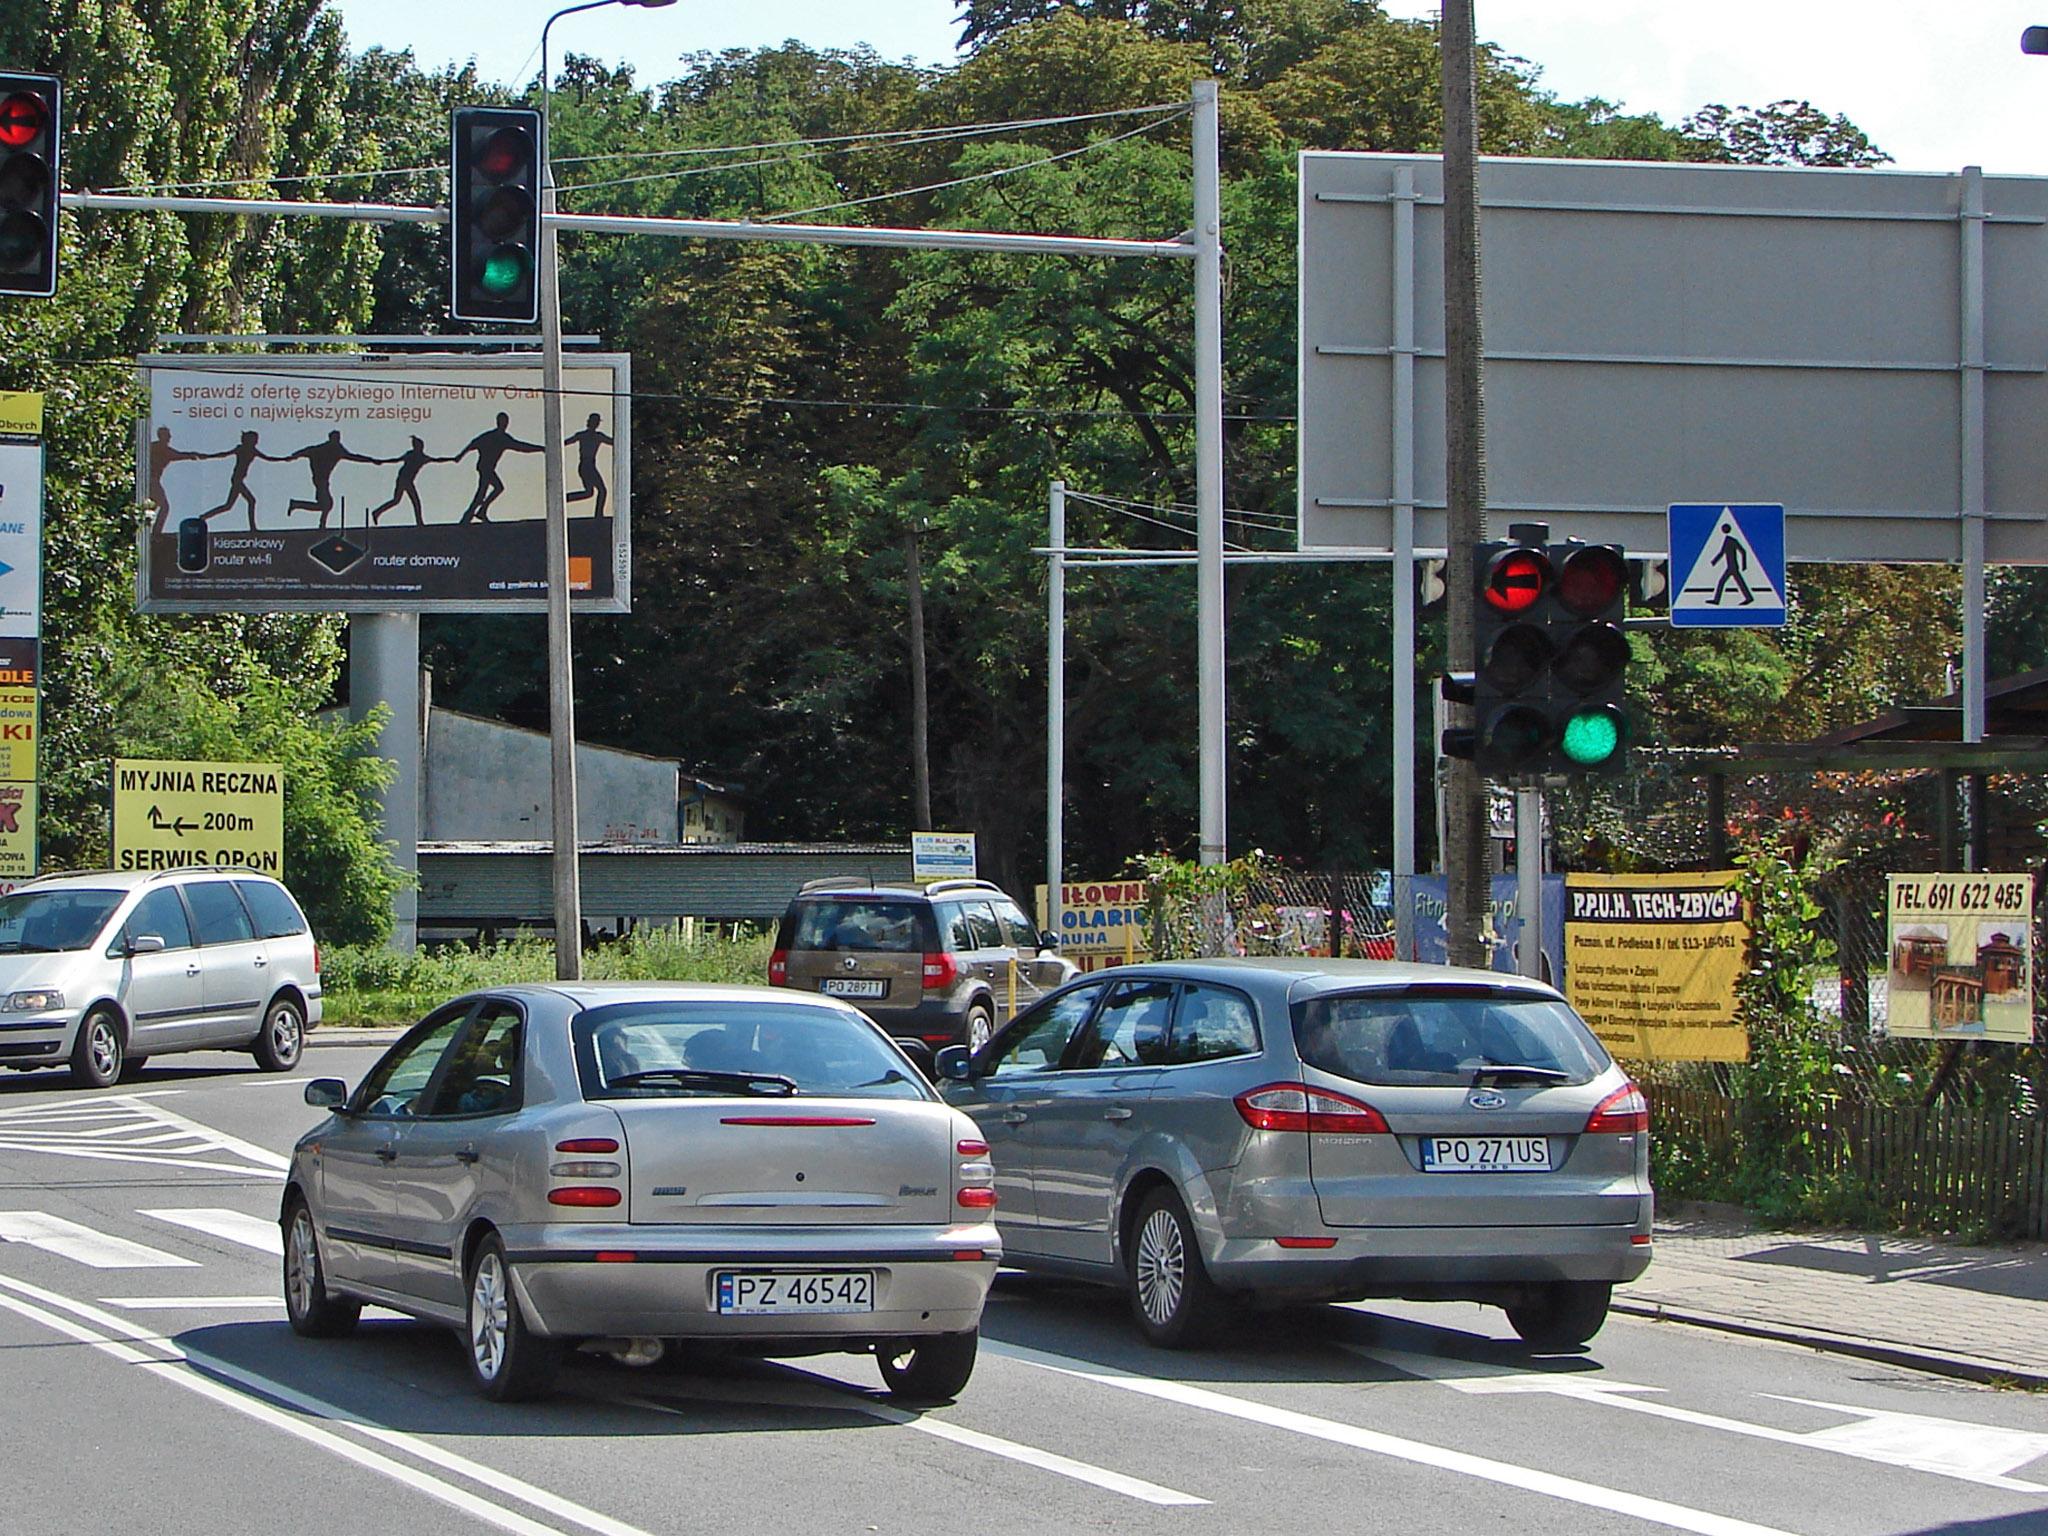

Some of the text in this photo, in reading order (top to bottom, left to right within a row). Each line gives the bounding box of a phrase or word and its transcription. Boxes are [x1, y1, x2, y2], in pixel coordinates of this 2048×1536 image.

[172, 383, 567, 402] sprawdź ofertę szybkiego Internetu w Oran
[188, 403, 228, 418] sieci
[234, 405, 244, 418] o
[250, 403, 360, 422] największym
[367, 405, 432, 423] zasięgu
[213, 537, 286, 551] kieszonkowy
[213, 552, 272, 566] router wi-fi
[373, 554, 461, 568] router domowy
[120, 770, 278, 795] MYJNIA RĘCZNA
[203, 812, 254, 832] 200m
[120, 849, 278, 871] SERWIS OPON
[1572, 891, 1738, 919] P.P.U.H. TECH-ZBYCH
[1896, 883, 2024, 910] TEL. 691 622 485
[1061, 931, 1108, 945] AUNA
[827, 980, 881, 993] PO 289TT
[1437, 1140, 1546, 1164] PO 271US
[738, 1277, 868, 1305] PZ 46542
